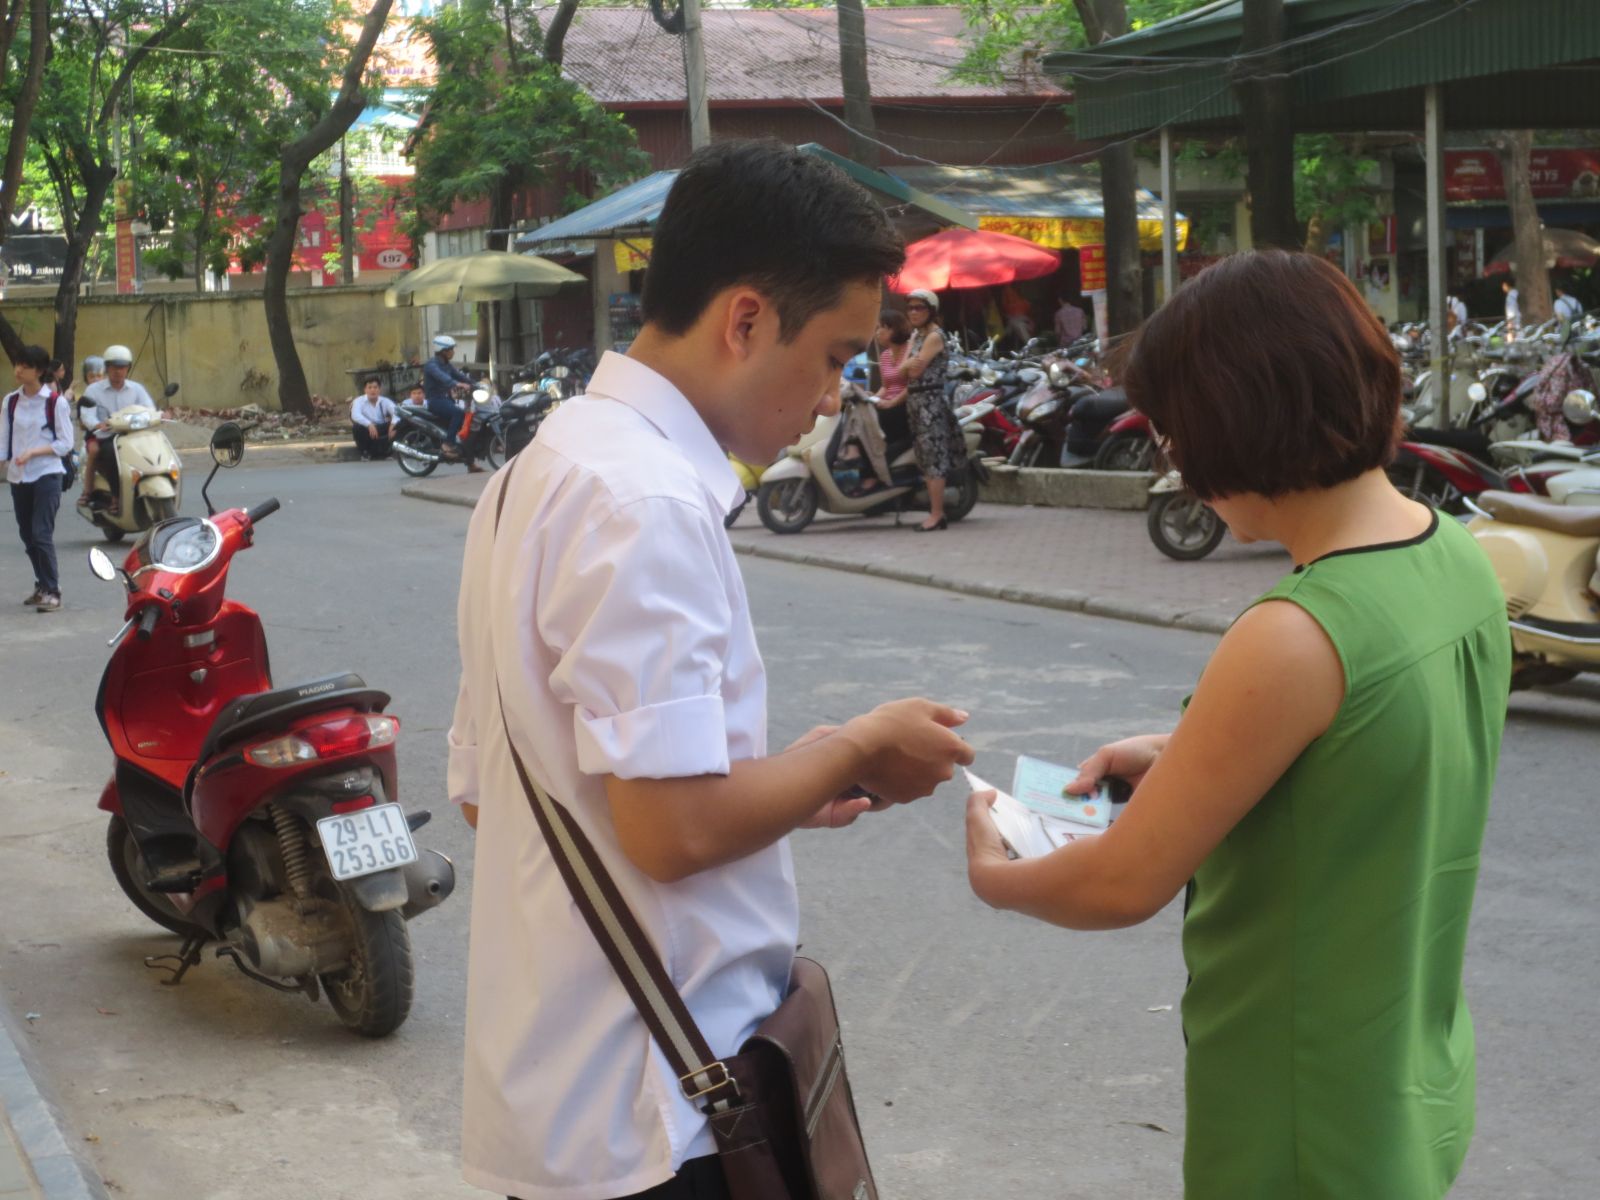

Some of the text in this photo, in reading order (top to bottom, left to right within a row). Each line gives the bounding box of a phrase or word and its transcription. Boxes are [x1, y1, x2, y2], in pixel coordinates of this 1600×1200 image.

[298, 682, 335, 697] PIAGGIO
[331, 810, 393, 847] 29-L1
[333, 836, 410, 876] 253.66
